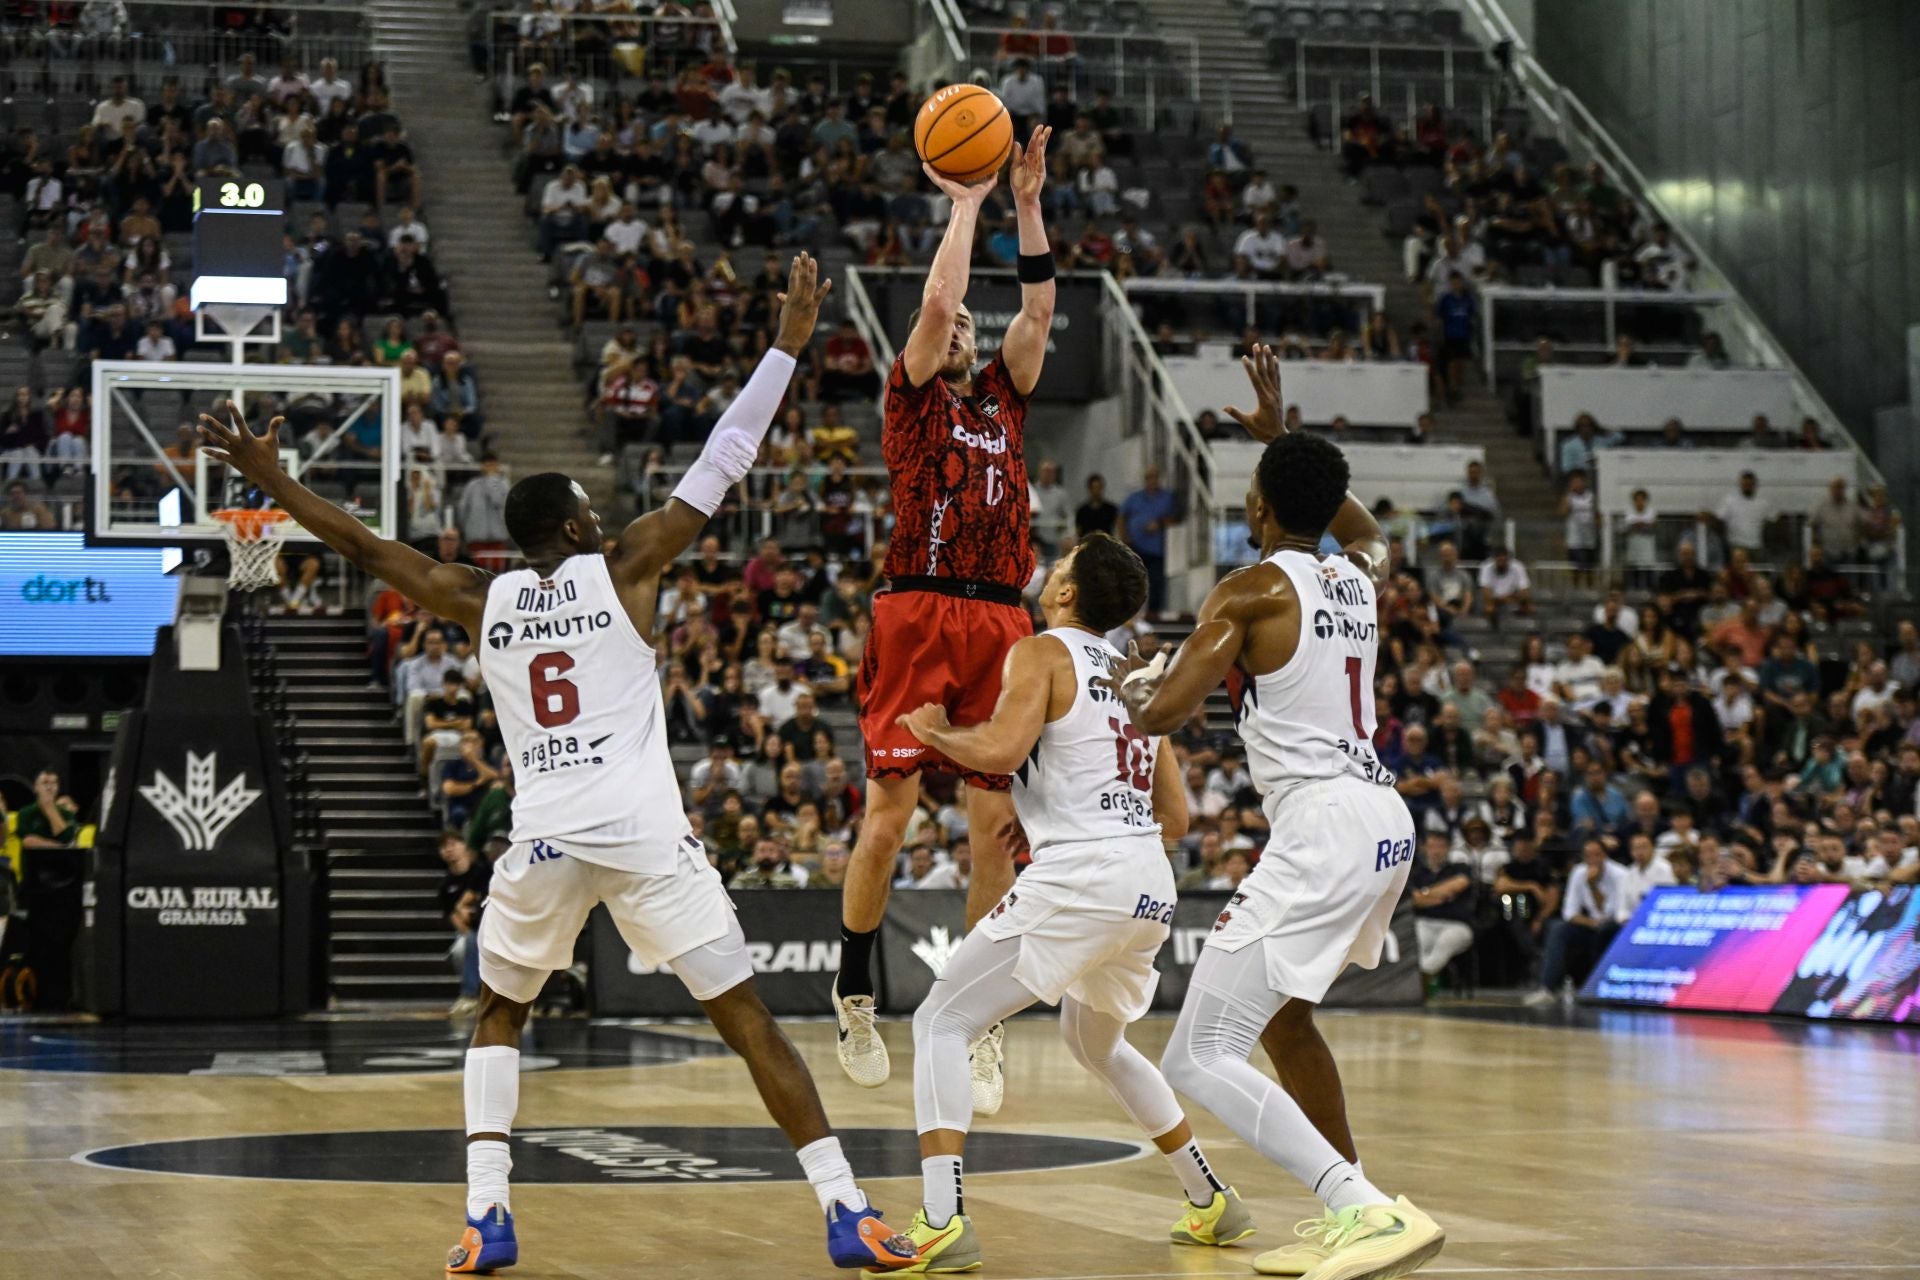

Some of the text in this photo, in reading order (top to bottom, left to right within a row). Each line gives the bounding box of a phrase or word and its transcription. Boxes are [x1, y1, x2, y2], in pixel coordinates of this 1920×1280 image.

[219, 182, 265, 208] 3.0
[516, 579, 577, 613] DIALLO
[519, 610, 612, 642] AMUTIO
[528, 651, 581, 729] 6
[1344, 656, 1369, 740] 1
[1108, 716, 1154, 792] 10
[127, 886, 279, 909] CAJA RURAL
[157, 909, 247, 926] GRANADA
